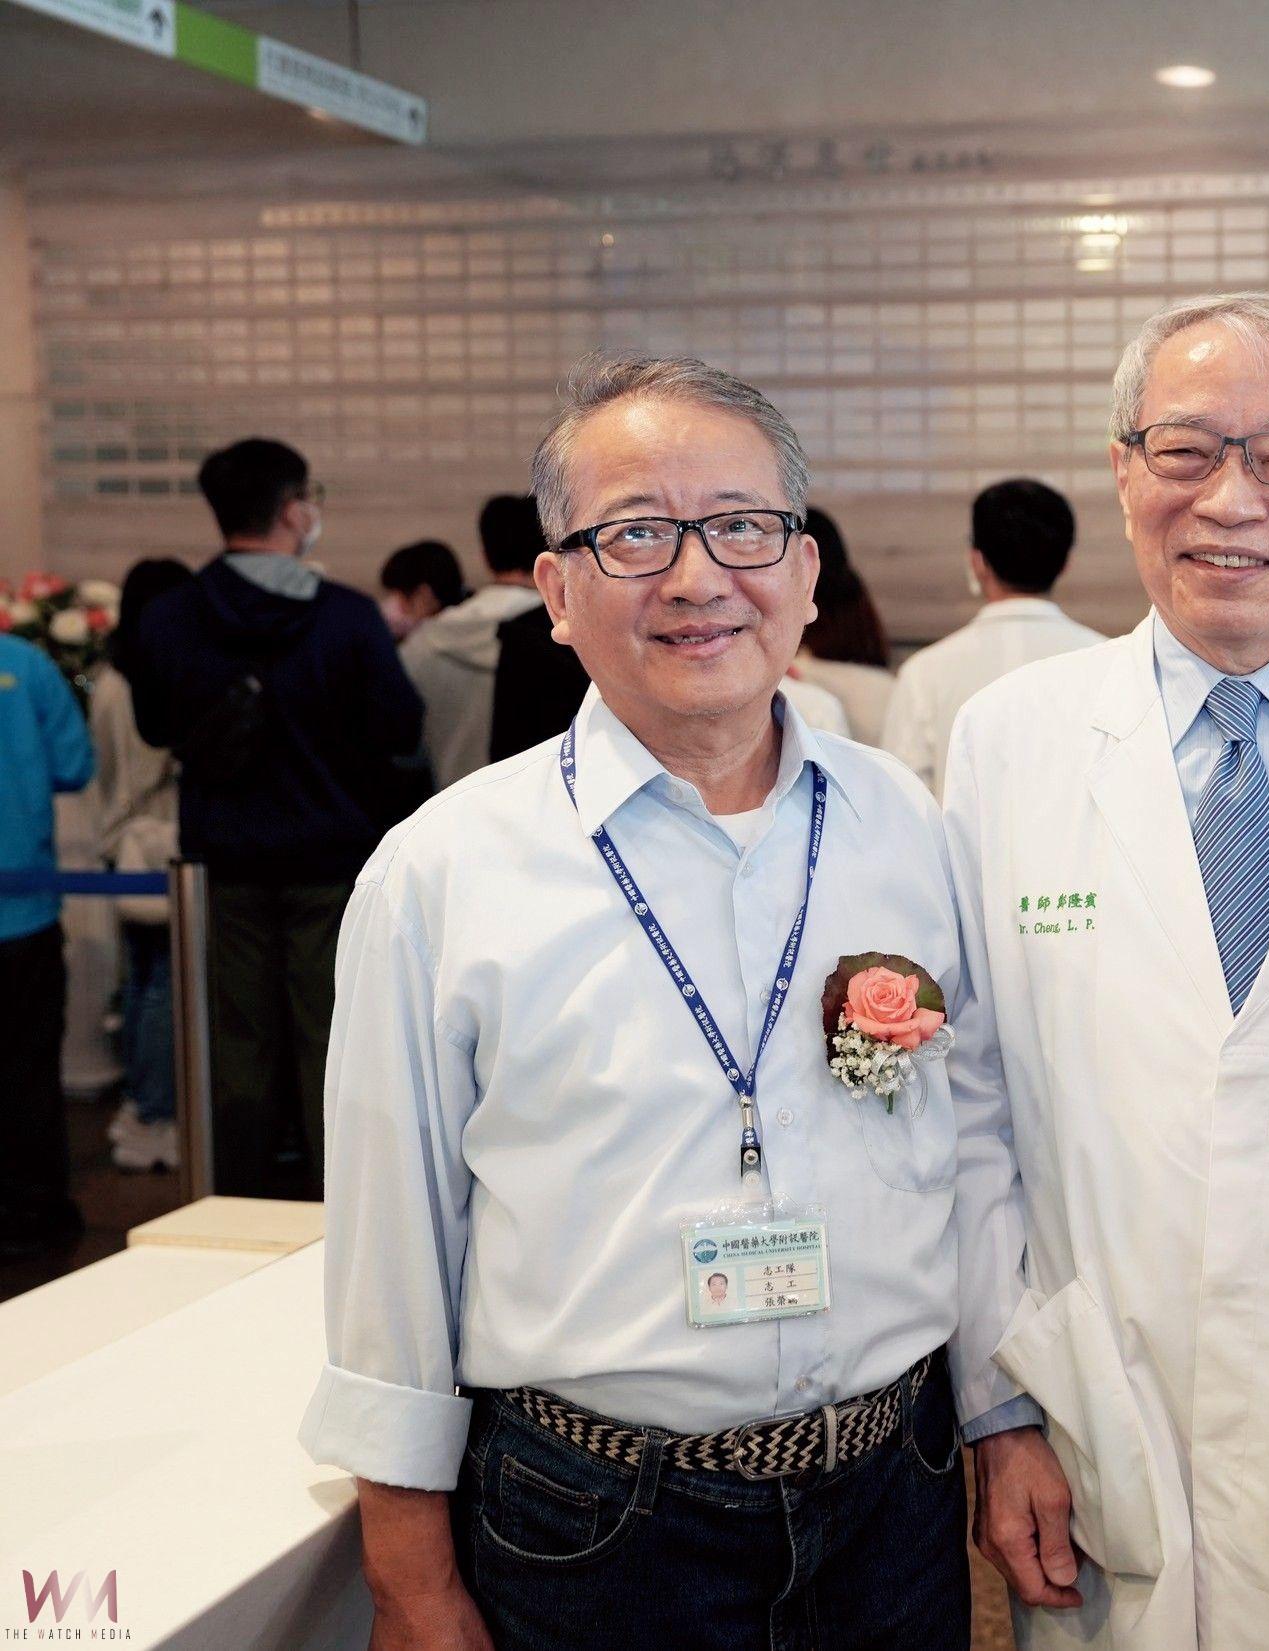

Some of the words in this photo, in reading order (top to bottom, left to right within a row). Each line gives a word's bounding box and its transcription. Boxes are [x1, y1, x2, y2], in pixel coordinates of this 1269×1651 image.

[1067, 919, 1077, 931] L.
[1085, 918, 1095, 930] P.
[722, 1231, 820, 1252] 中國醫藥大學附設醫院
[763, 1263, 796, 1276] 志工隊
